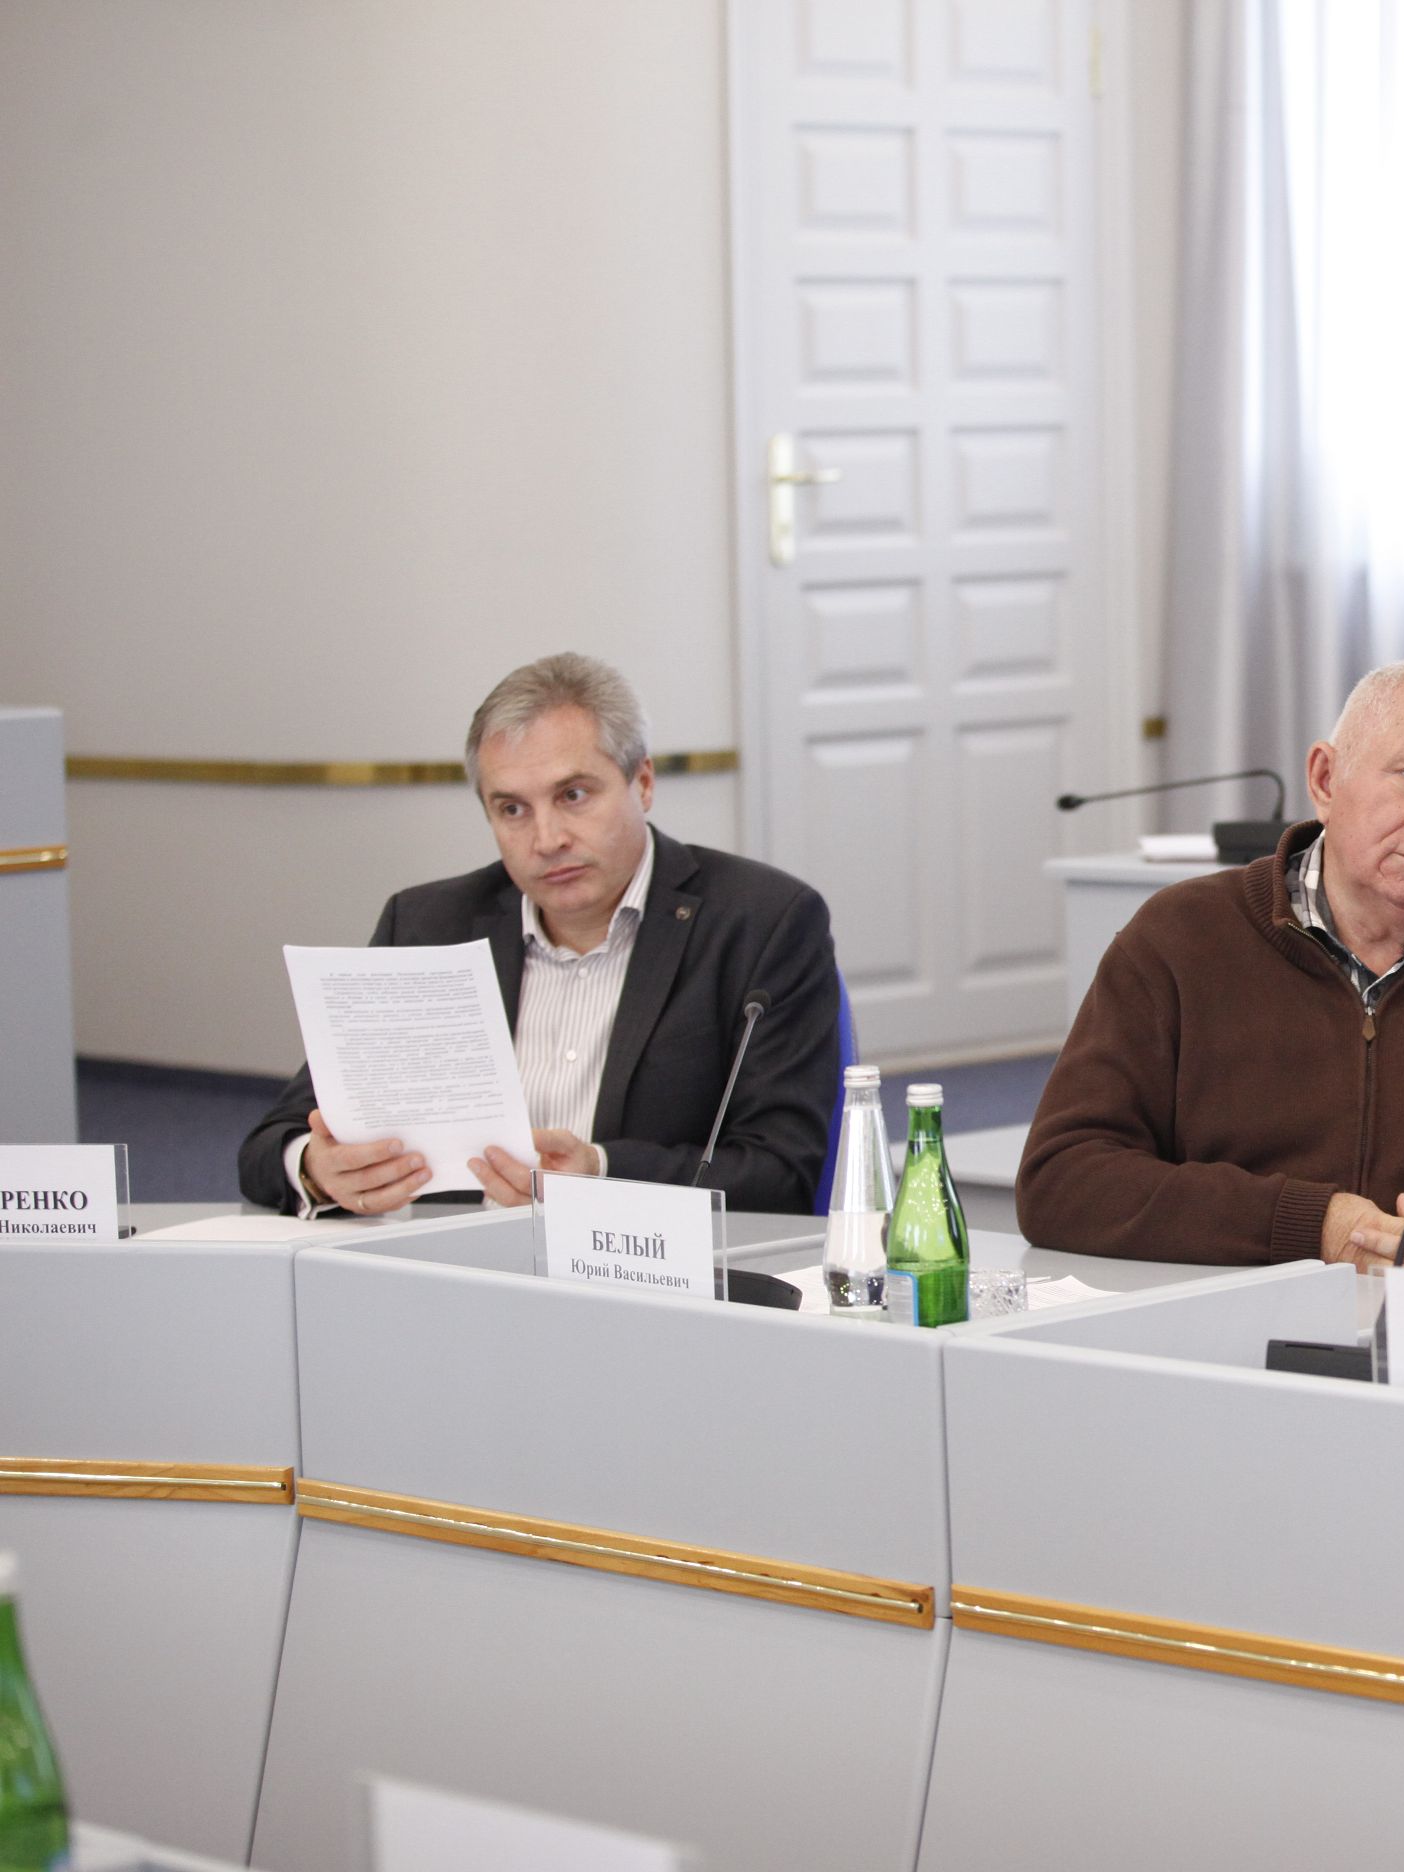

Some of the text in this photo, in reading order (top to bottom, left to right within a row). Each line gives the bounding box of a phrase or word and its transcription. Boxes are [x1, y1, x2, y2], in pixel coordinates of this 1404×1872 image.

[0, 1219, 97, 1234] Николаевич
[592, 1230, 667, 1260] БЕЛЫЙ
[571, 1258, 690, 1289] Юрий Васильевич
